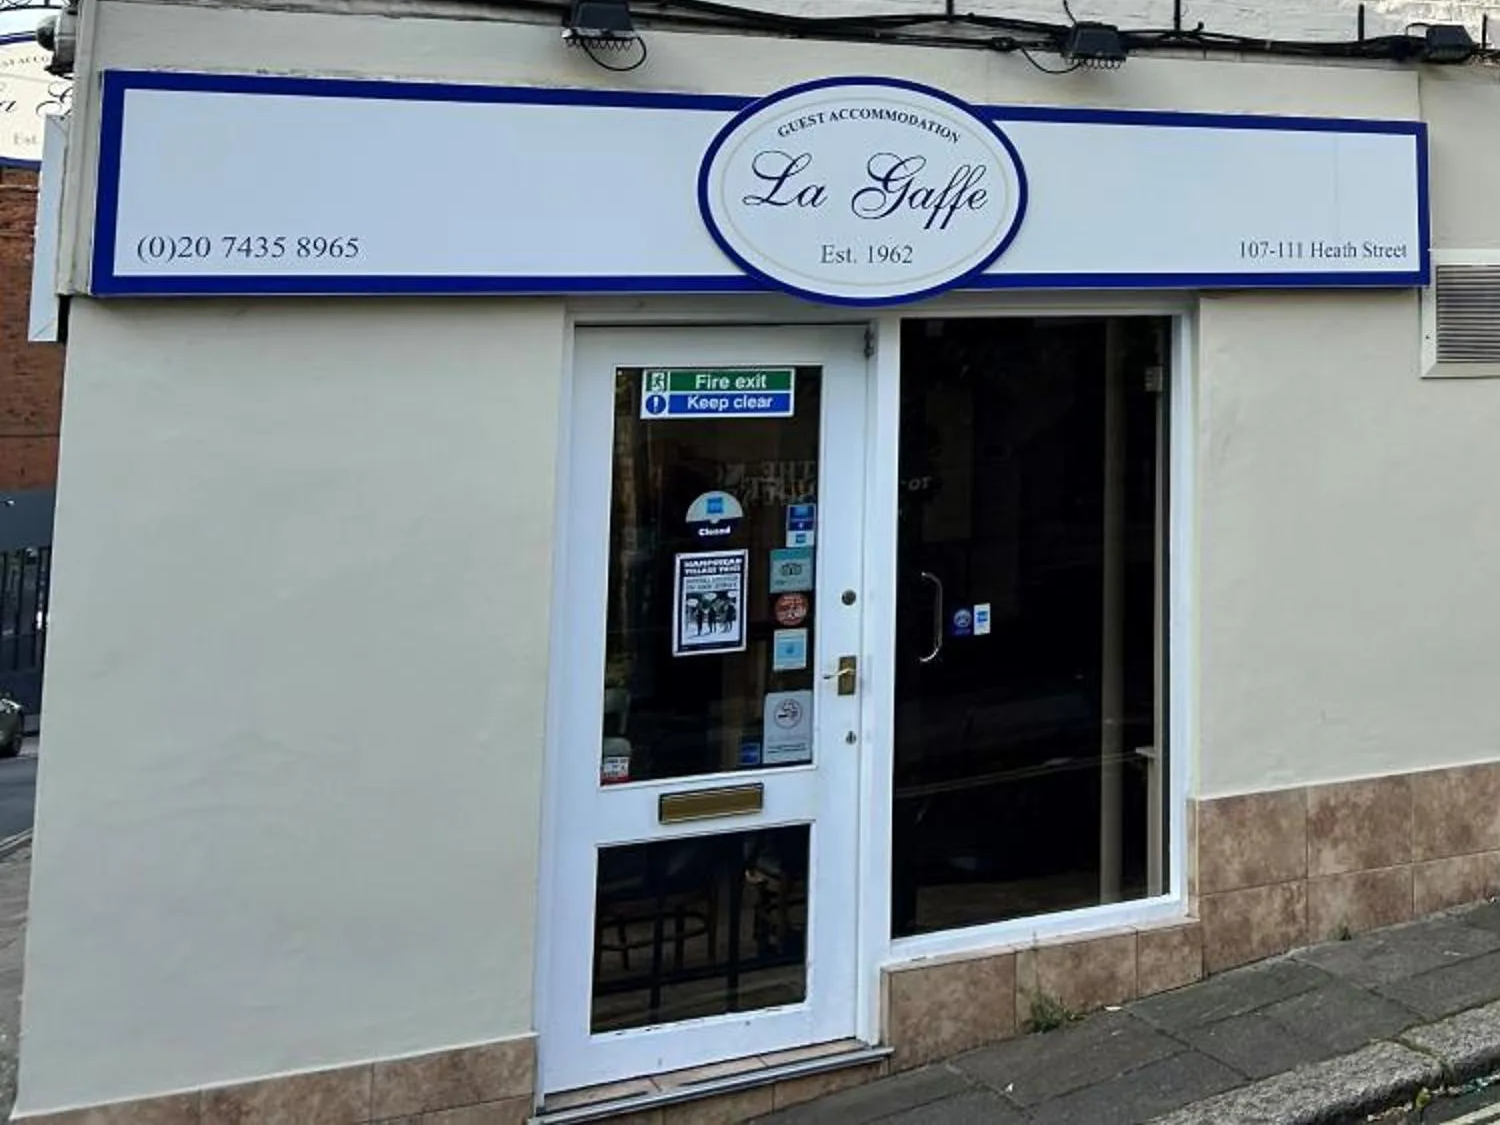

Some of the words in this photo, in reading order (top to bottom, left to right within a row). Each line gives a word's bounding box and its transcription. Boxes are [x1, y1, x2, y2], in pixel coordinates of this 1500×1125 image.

[777, 110, 825, 138] GUEST
[829, 107, 961, 144] ACCOMMODATION
[742, 150, 827, 208] La
[851, 151, 989, 230] Gaffe
[137, 235, 211, 263] (0)20
[221, 236, 287, 258] 7435
[296, 236, 359, 258] 8965
[820, 243, 857, 264] Est.
[867, 243, 913, 264] 1962
[1240, 241, 1302, 258] 107-111
[1310, 241, 1357, 258] Heath
[1362, 242, 1407, 258] Street
[695, 374, 730, 389] Fire
[735, 373, 767, 389] exit
[687, 396, 729, 411] Keep
[733, 394, 773, 408] clear
